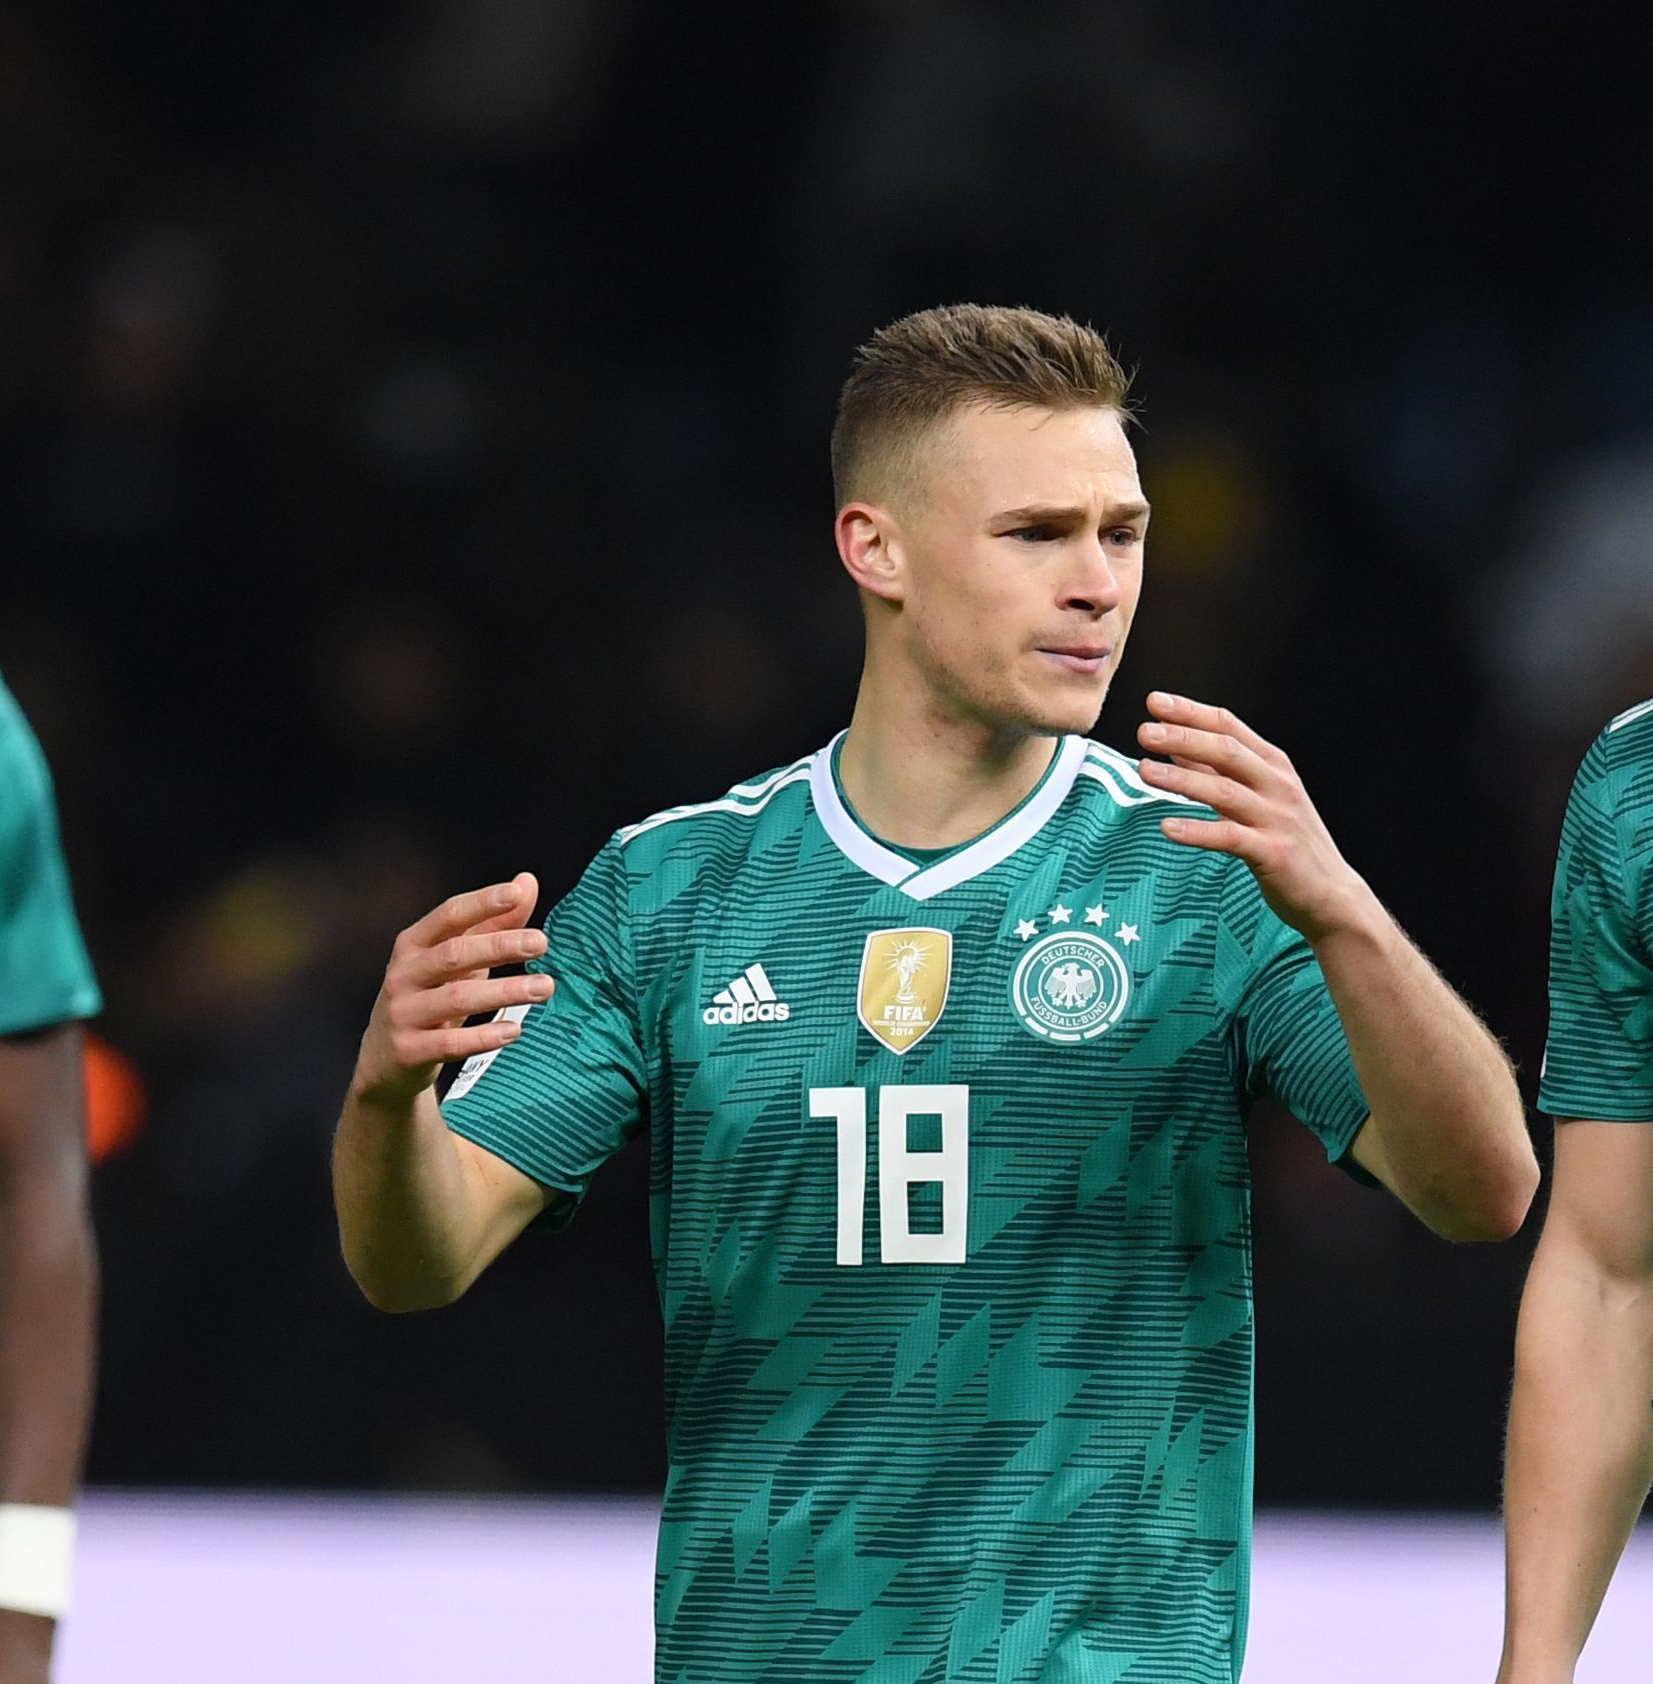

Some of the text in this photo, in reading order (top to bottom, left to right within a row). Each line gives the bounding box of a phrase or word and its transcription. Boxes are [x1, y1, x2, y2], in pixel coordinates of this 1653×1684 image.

[1041, 945, 1105, 968] DEUTSCHER
[703, 1001, 790, 1025] adidas
[884, 1005, 924, 1021] FIFA
[890, 1027, 914, 1036] 2014
[809, 1084, 970, 1266] 18
